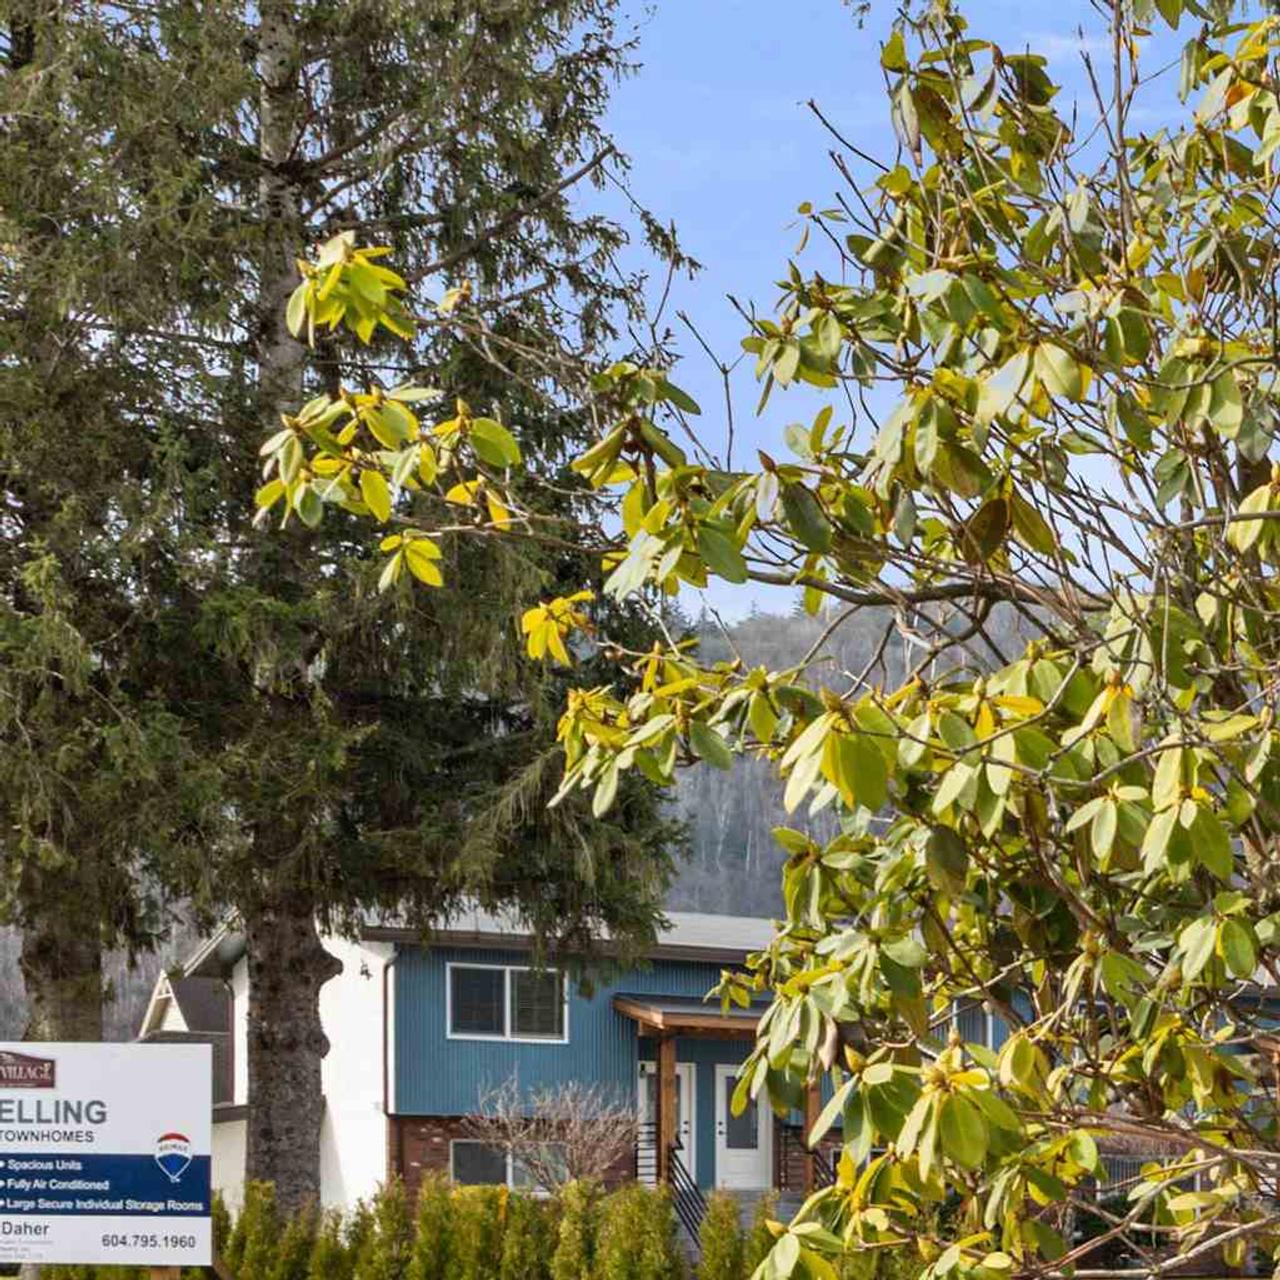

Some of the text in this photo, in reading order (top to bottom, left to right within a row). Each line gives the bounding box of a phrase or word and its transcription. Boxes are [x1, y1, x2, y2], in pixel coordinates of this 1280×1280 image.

[8, 1159, 82, 1171] Spacious Units
[7, 1179, 110, 1191] Fully Air Conditioned
[6, 1198, 203, 1213] Large Secure Individual Storage Rooms
[2, 1221, 196, 1248] Daher 604.795.1960
